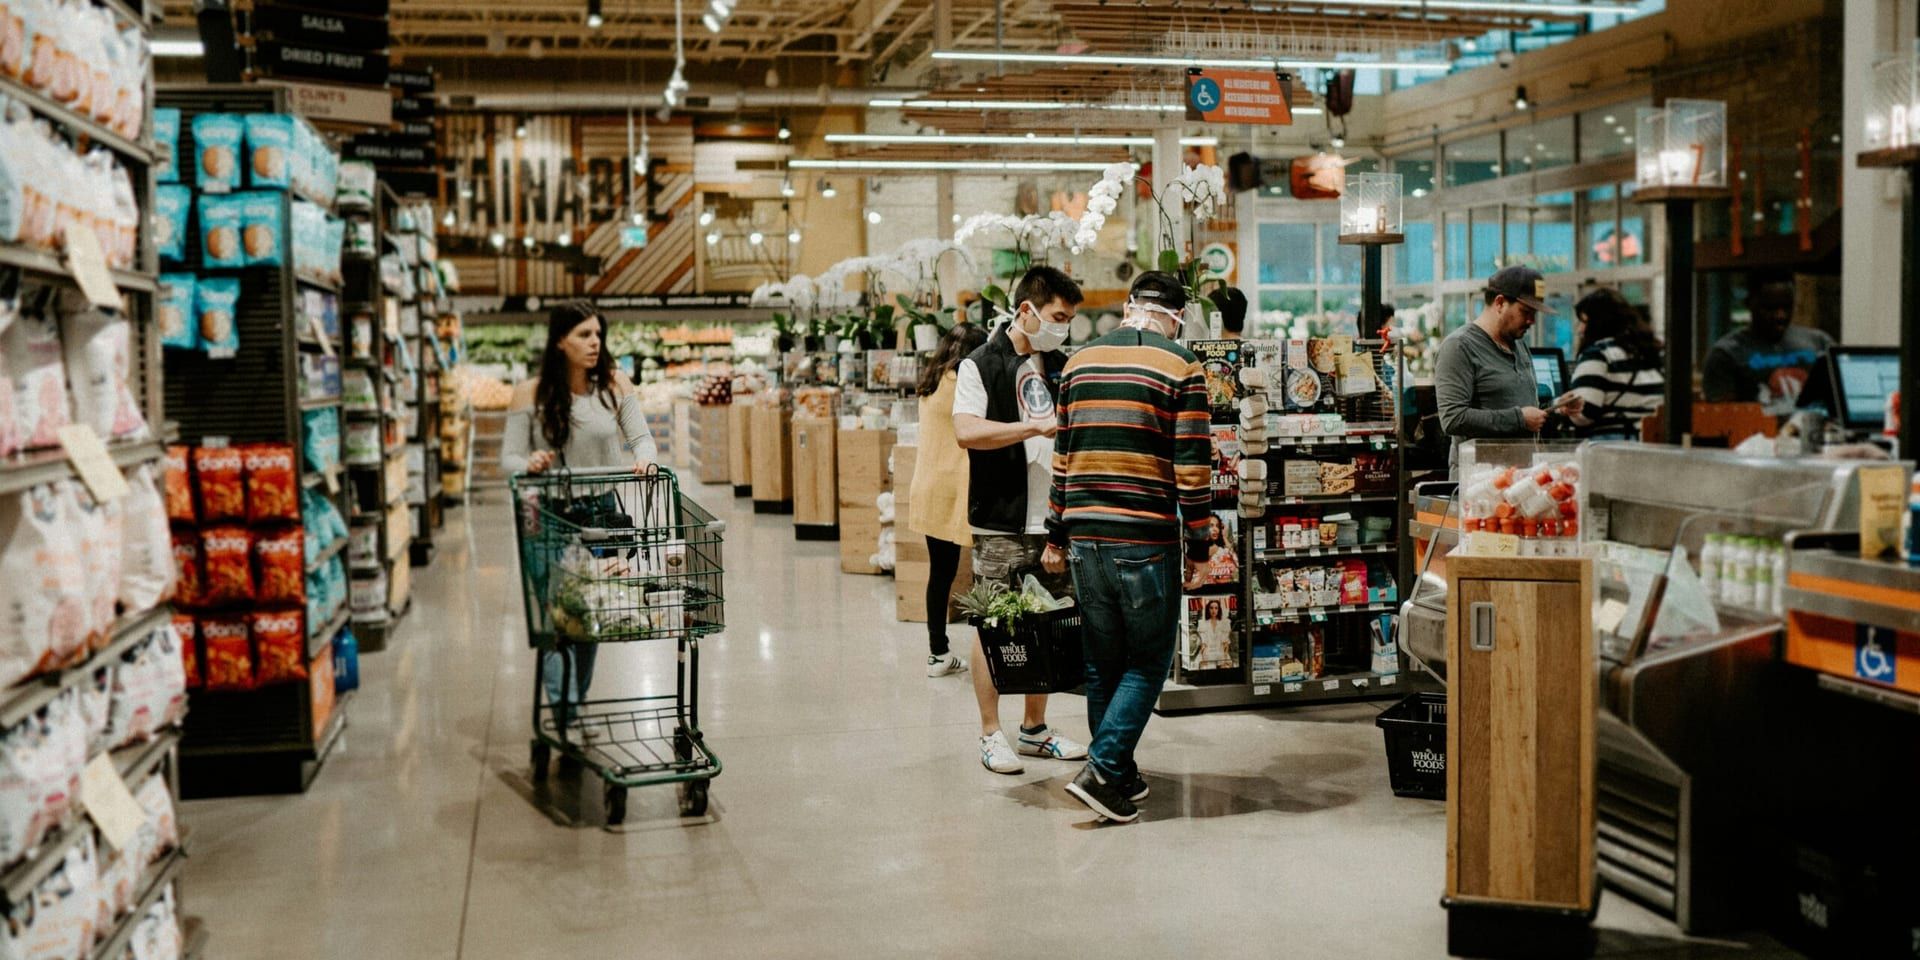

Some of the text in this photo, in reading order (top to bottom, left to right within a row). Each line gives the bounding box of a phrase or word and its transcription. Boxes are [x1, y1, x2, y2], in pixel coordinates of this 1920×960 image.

[302, 15, 345, 33] SALSA
[281, 47, 365, 69] DRIED FRUIT
[300, 88, 346, 104] CLINT'S
[355, 145, 392, 157] CEREAL
[1689, 143, 1705, 185] 7
[1192, 343, 1238, 352] PLANT-BASED
[197, 455, 243, 473] dang
[245, 454, 291, 471] dang
[204, 536, 249, 553] dang
[255, 538, 300, 556] dang
[203, 621, 248, 639] dang
[253, 616, 298, 634] dang
[1000, 644, 1027, 654] WHOLE
[1002, 653, 1028, 662] FOODS
[1411, 750, 1446, 761] WHOLE
[1413, 759, 1445, 770] FOODS
